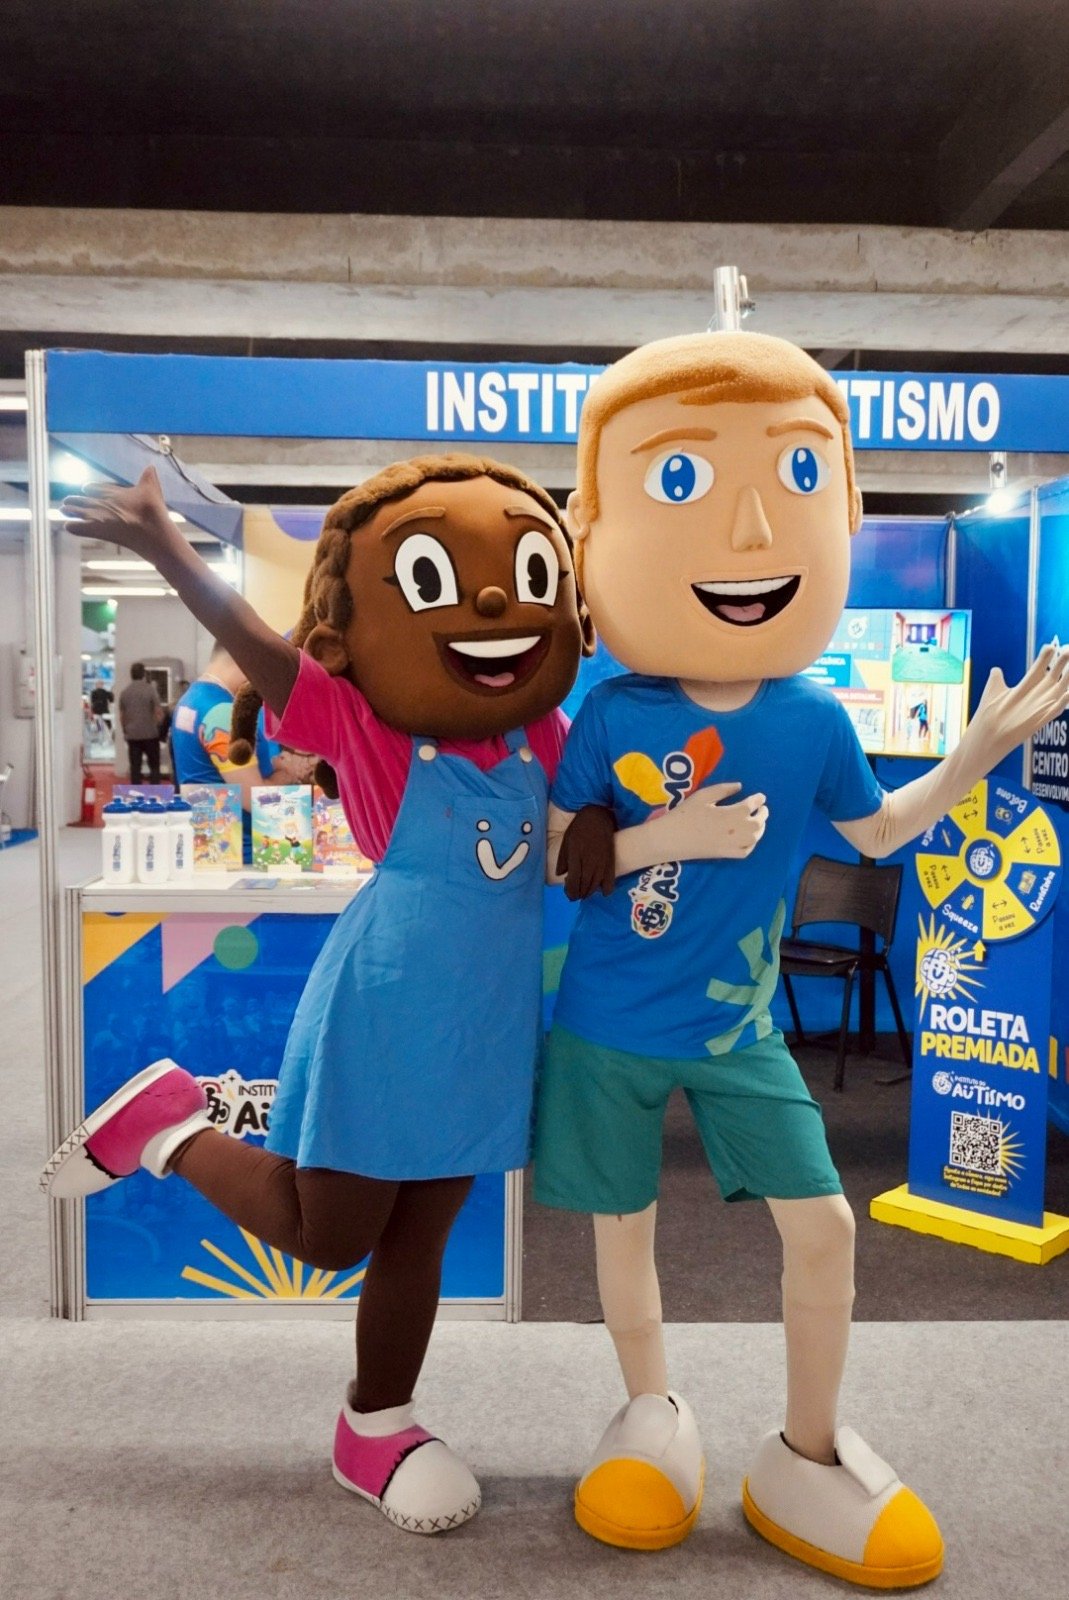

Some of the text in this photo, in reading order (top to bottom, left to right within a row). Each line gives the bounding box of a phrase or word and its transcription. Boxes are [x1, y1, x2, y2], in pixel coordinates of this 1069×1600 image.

[427, 371, 599, 433] INSTIT
[1033, 751, 1069, 778] CENTRO
[942, 904, 978, 933] Squeeze
[930, 1004, 1030, 1043] ROLETA
[921, 1031, 1040, 1074] PREMIADA
[239, 1084, 277, 1096] INSTIT
